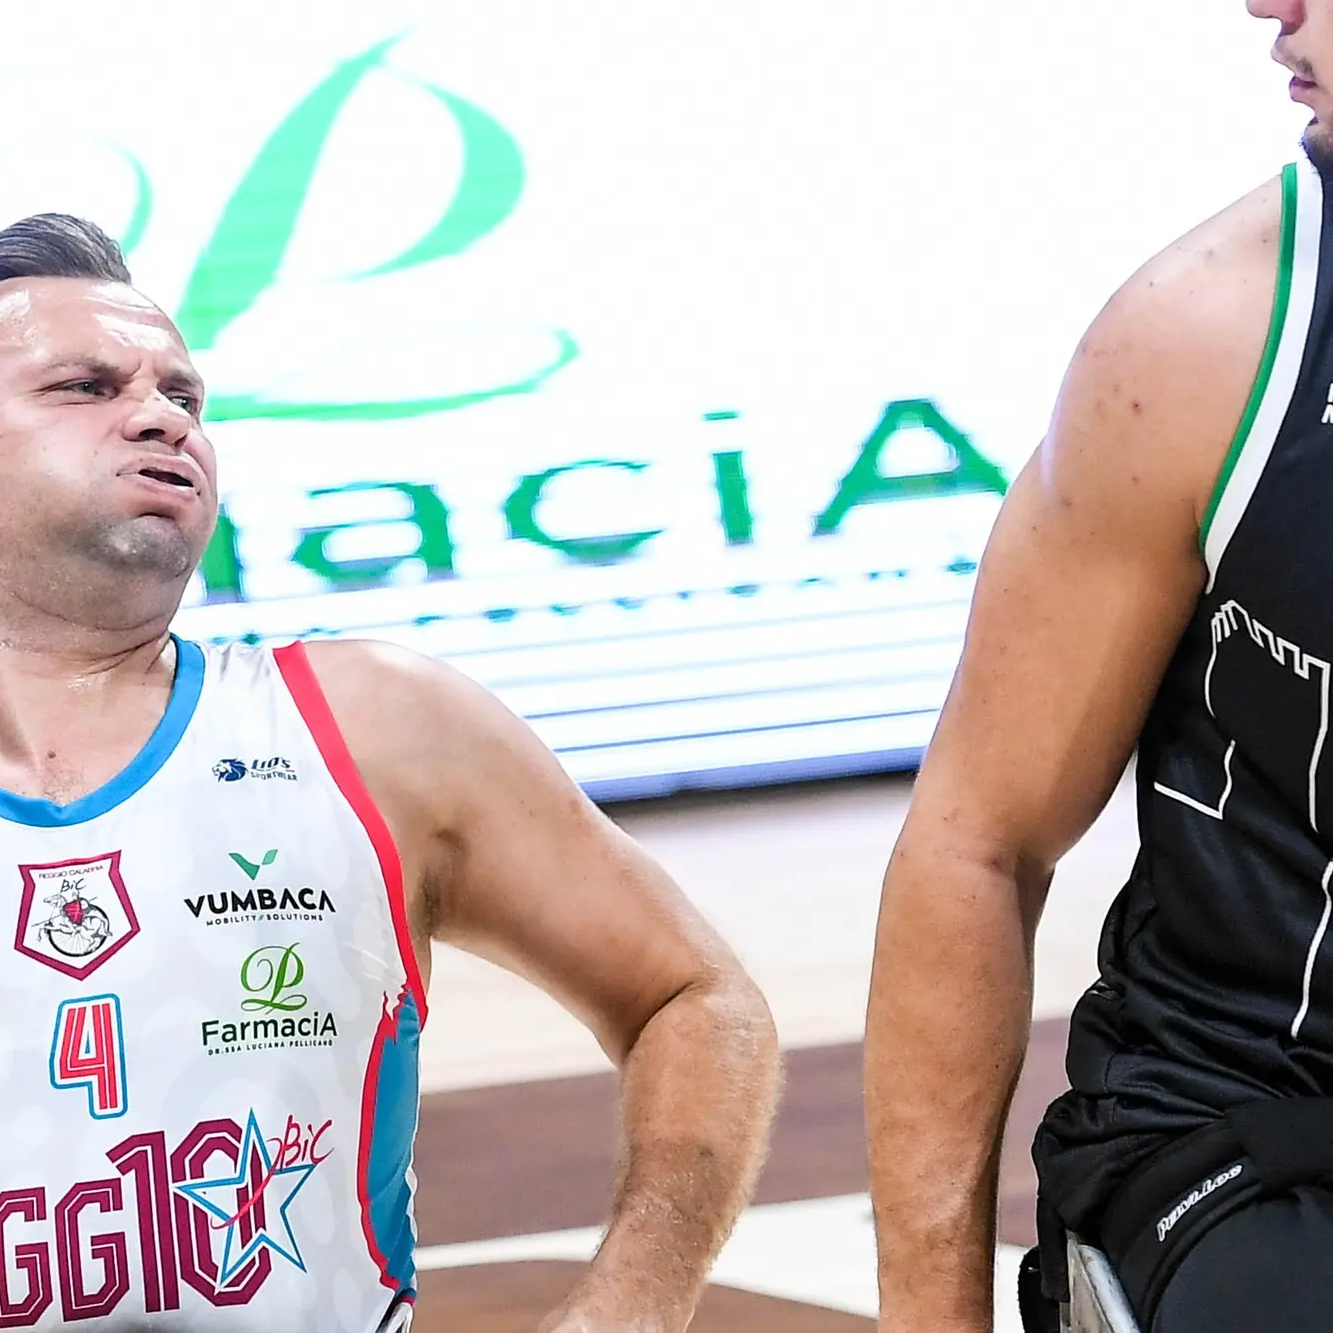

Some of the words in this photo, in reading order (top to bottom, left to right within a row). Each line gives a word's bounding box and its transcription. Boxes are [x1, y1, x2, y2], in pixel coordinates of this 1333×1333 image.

[183, 887, 337, 919] VUMBACA
[201, 1011, 338, 1047] FarmaciA
[246, 1041, 285, 1051] LUCIANA
[49, 993, 128, 1120] 4
